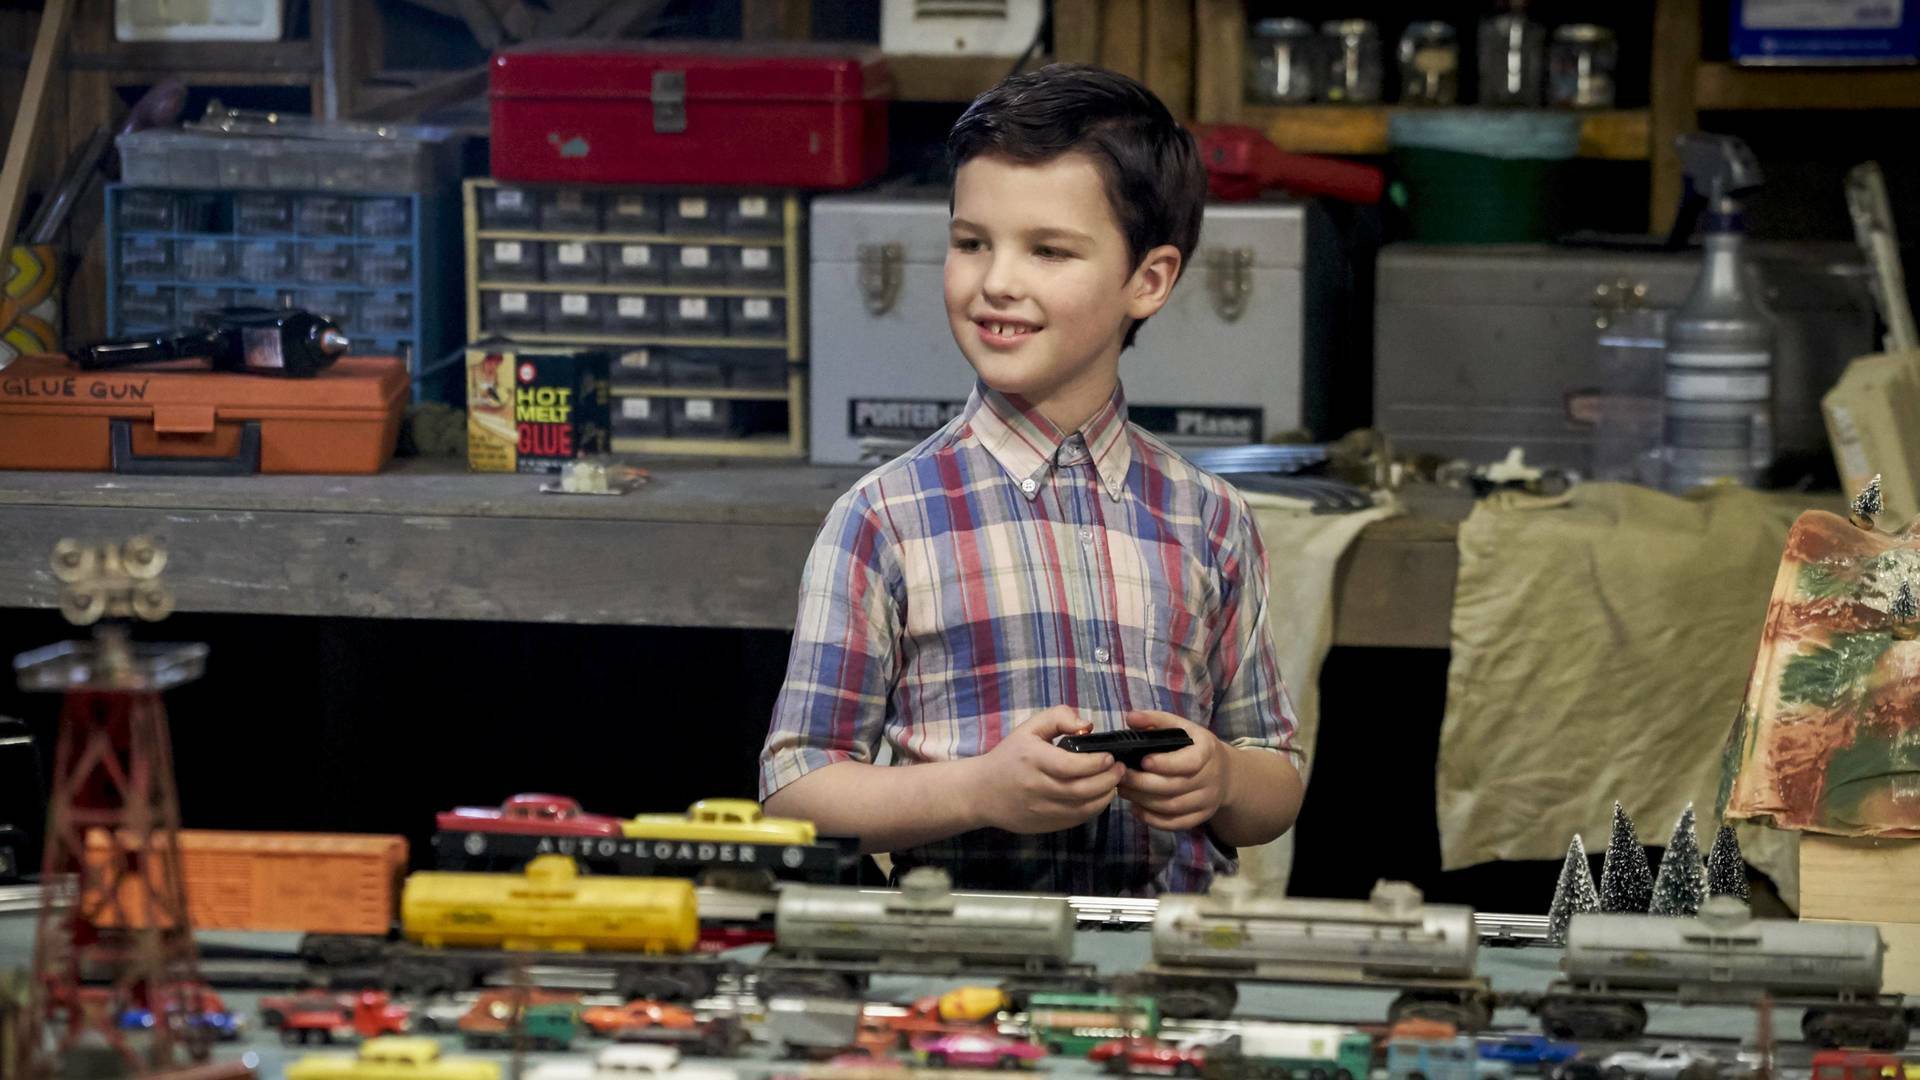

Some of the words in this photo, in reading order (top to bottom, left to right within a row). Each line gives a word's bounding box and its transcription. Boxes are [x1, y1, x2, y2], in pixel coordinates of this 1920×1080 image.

[3, 377, 76, 397] GLUE
[90, 379, 149, 399] GUN
[517, 387, 572, 406] HOT
[517, 405, 572, 423] MELT
[1176, 411, 1252, 435] Plane
[518, 423, 573, 456] GLUE
[535, 837, 757, 862] AUTO-LOADER
